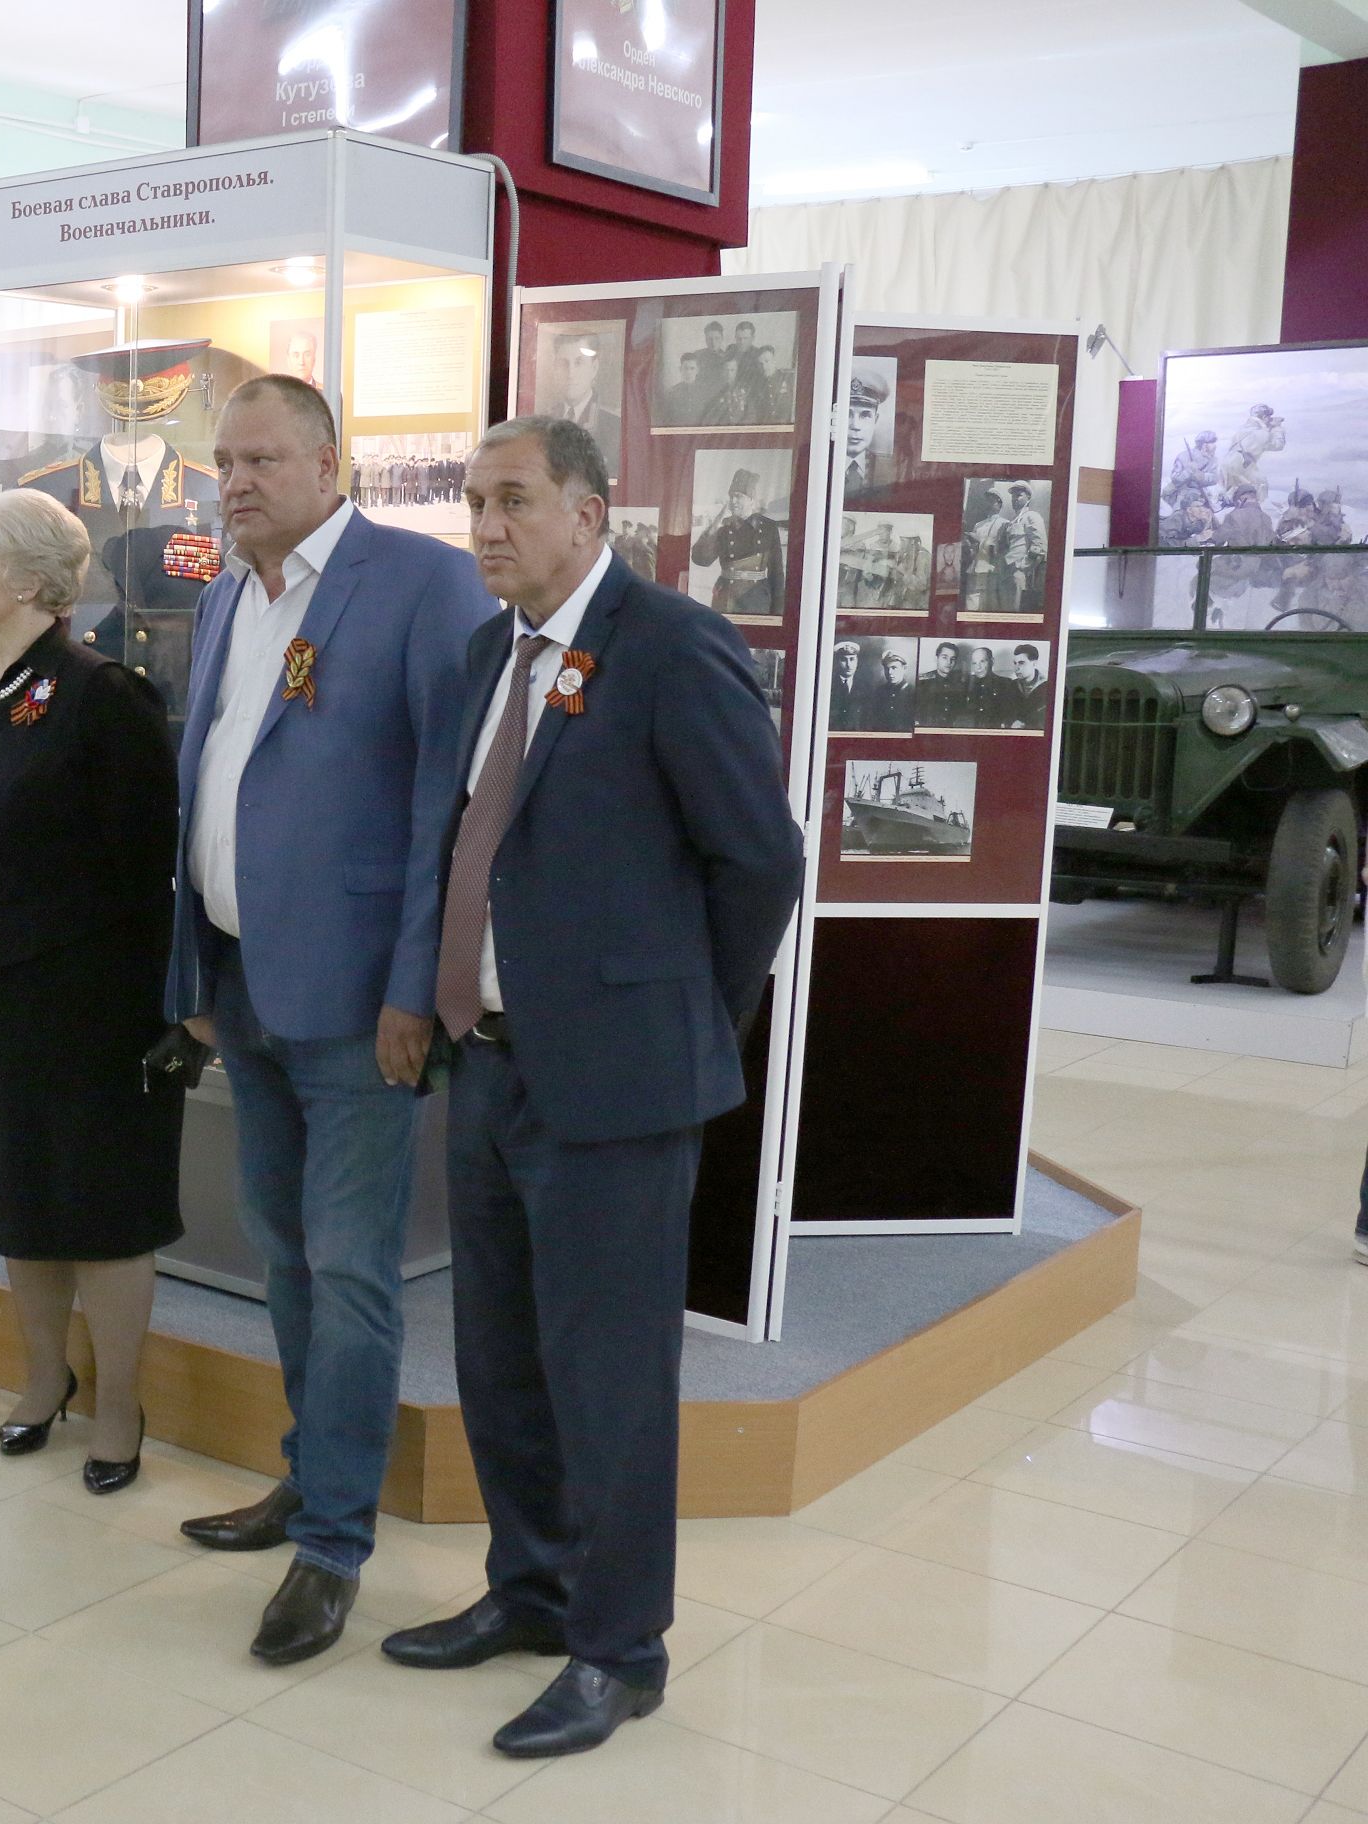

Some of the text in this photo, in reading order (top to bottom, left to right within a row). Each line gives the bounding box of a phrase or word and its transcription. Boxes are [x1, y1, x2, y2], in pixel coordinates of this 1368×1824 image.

[623, 40, 656, 67] Орден
[275, 72, 366, 105] Кутуза
[572, 53, 702, 109] лександра Невского
[290, 104, 356, 126] степеи
[10, 169, 275, 219] Боевая слава Ставрополья.
[59, 209, 216, 242] Военачальники.
